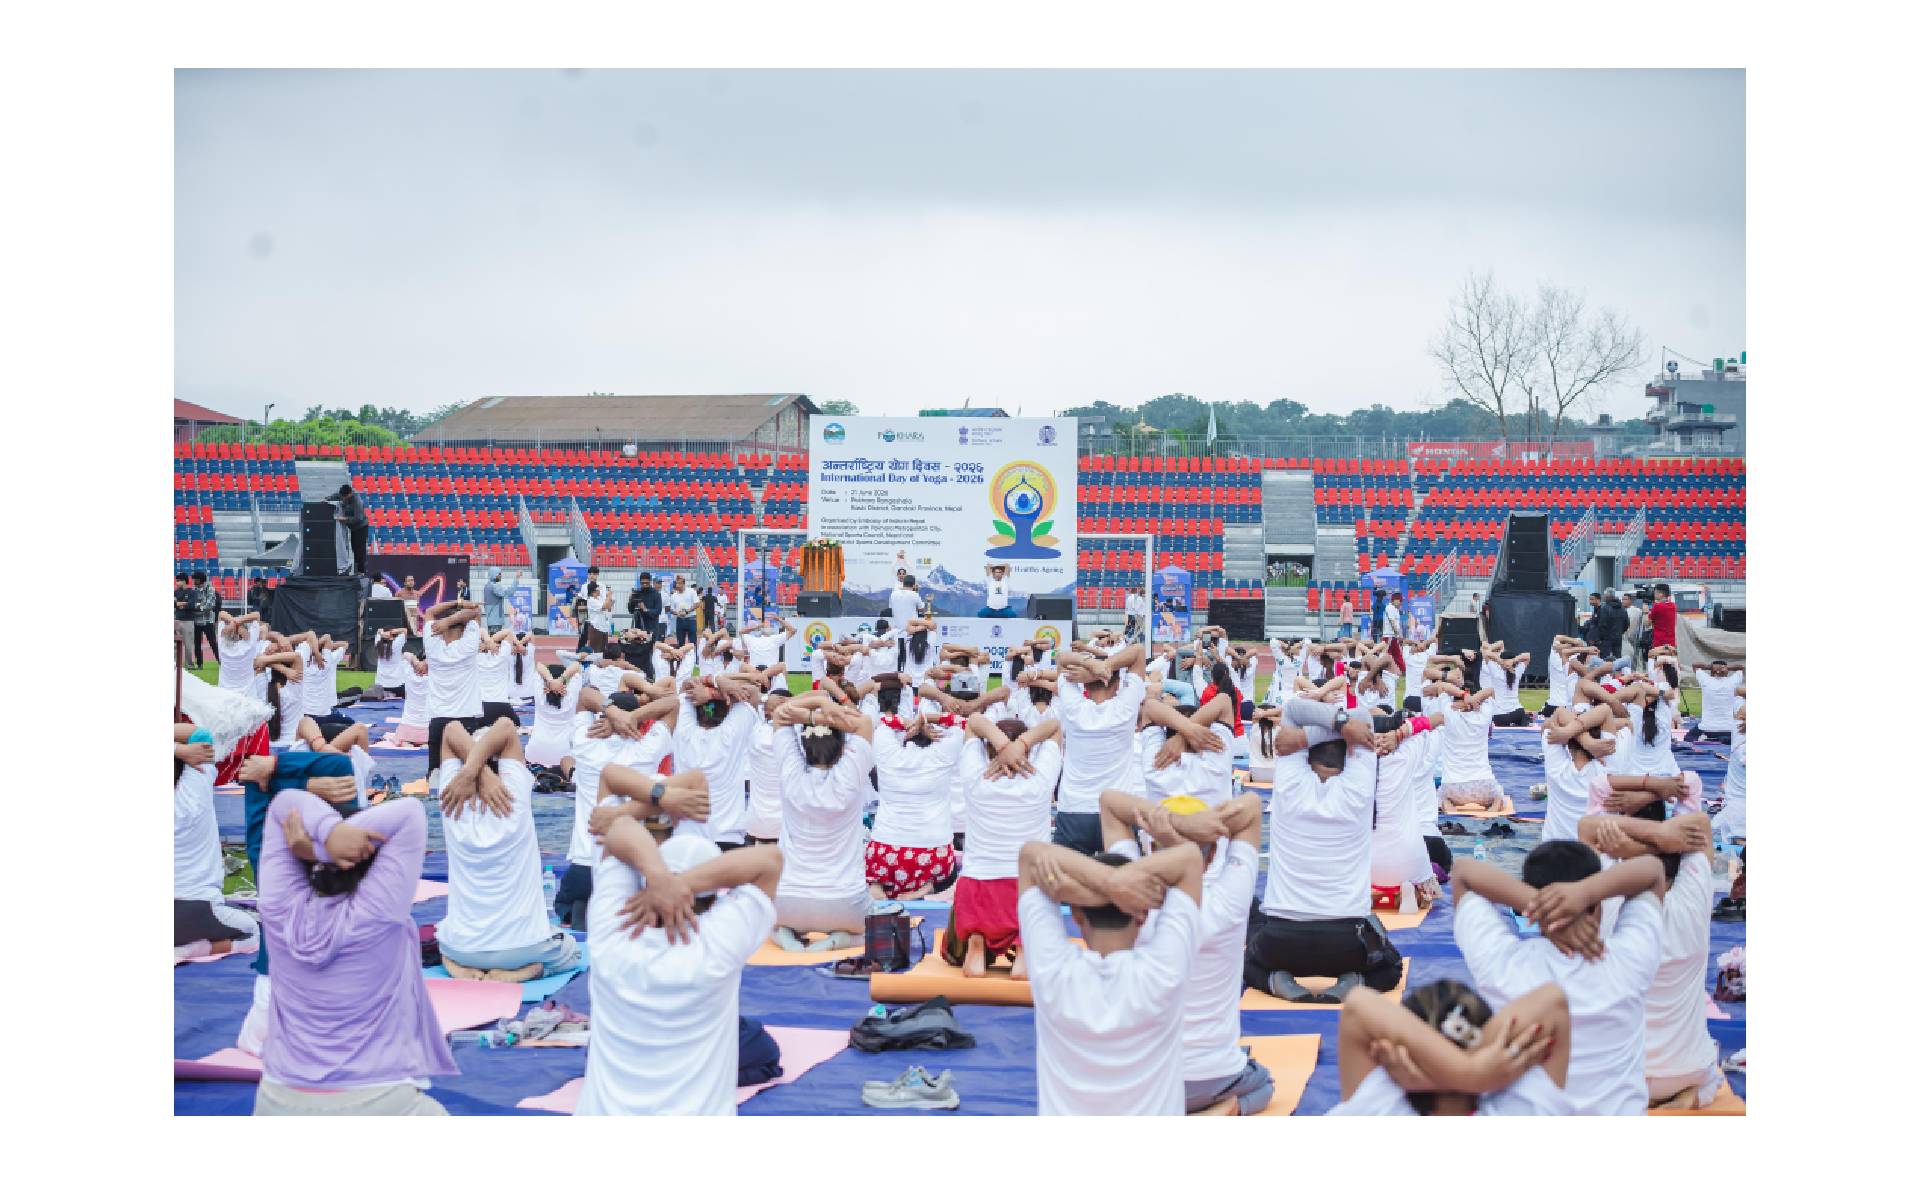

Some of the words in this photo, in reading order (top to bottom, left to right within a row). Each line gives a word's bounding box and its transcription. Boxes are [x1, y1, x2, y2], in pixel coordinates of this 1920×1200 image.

[888, 458, 910, 471] योग
[912, 458, 941, 473] दिवस
[954, 462, 984, 474] २०२६
[820, 473, 886, 482] International
[888, 473, 907, 484] Day
[910, 474, 920, 482] of
[923, 474, 948, 485] Yoga
[955, 474, 985, 483] 2026
[1014, 565, 1040, 574] Healthy
